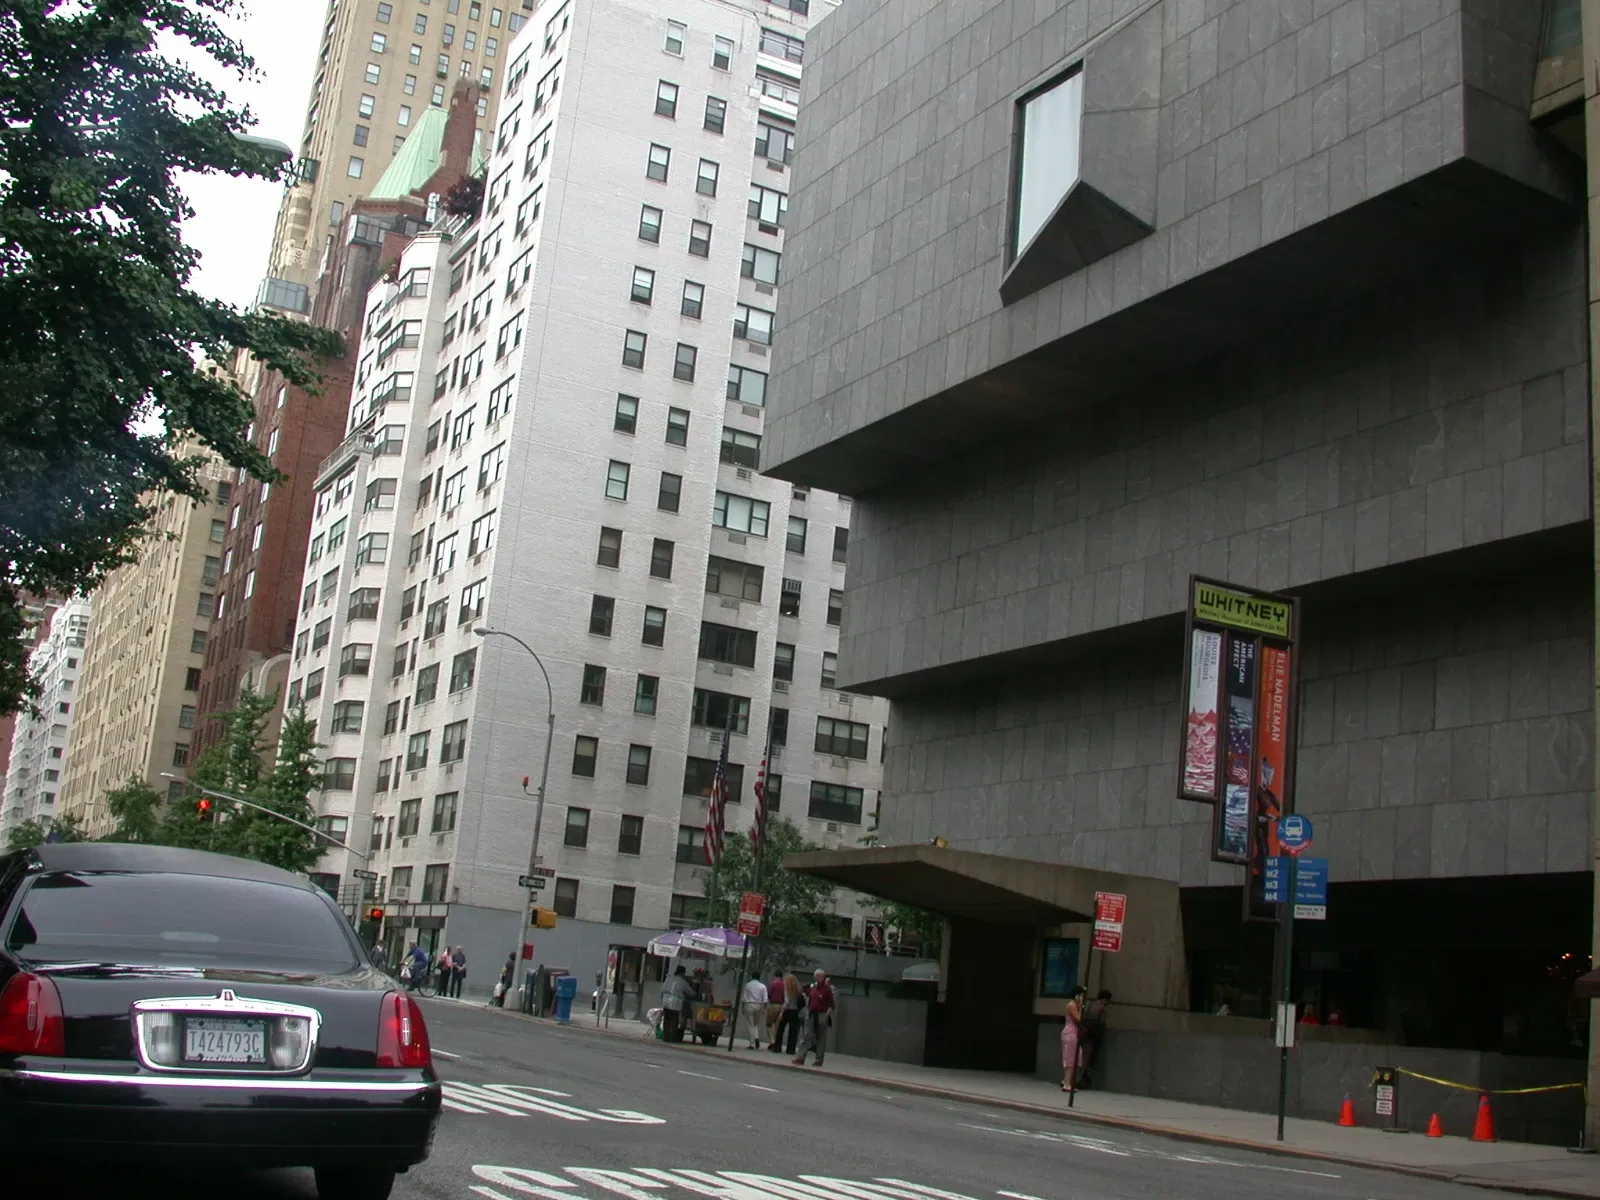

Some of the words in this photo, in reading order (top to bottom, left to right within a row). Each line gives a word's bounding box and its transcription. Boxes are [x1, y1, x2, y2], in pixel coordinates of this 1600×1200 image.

[1200, 590, 1285, 622] WHITNEY
[1202, 636, 1212, 681] BOURGEOIS
[1209, 636, 1218, 666] LOUISE
[1239, 641, 1247, 684] AMERICAN
[1276, 652, 1286, 676] ELIE
[1272, 678, 1284, 743] NADELMAN
[1266, 870, 1279, 878] M2
[1267, 858, 1279, 866] M1
[1264, 892, 1278, 901] M4
[1265, 881, 1279, 889] M3
[189, 1031, 260, 1054] T424793C
